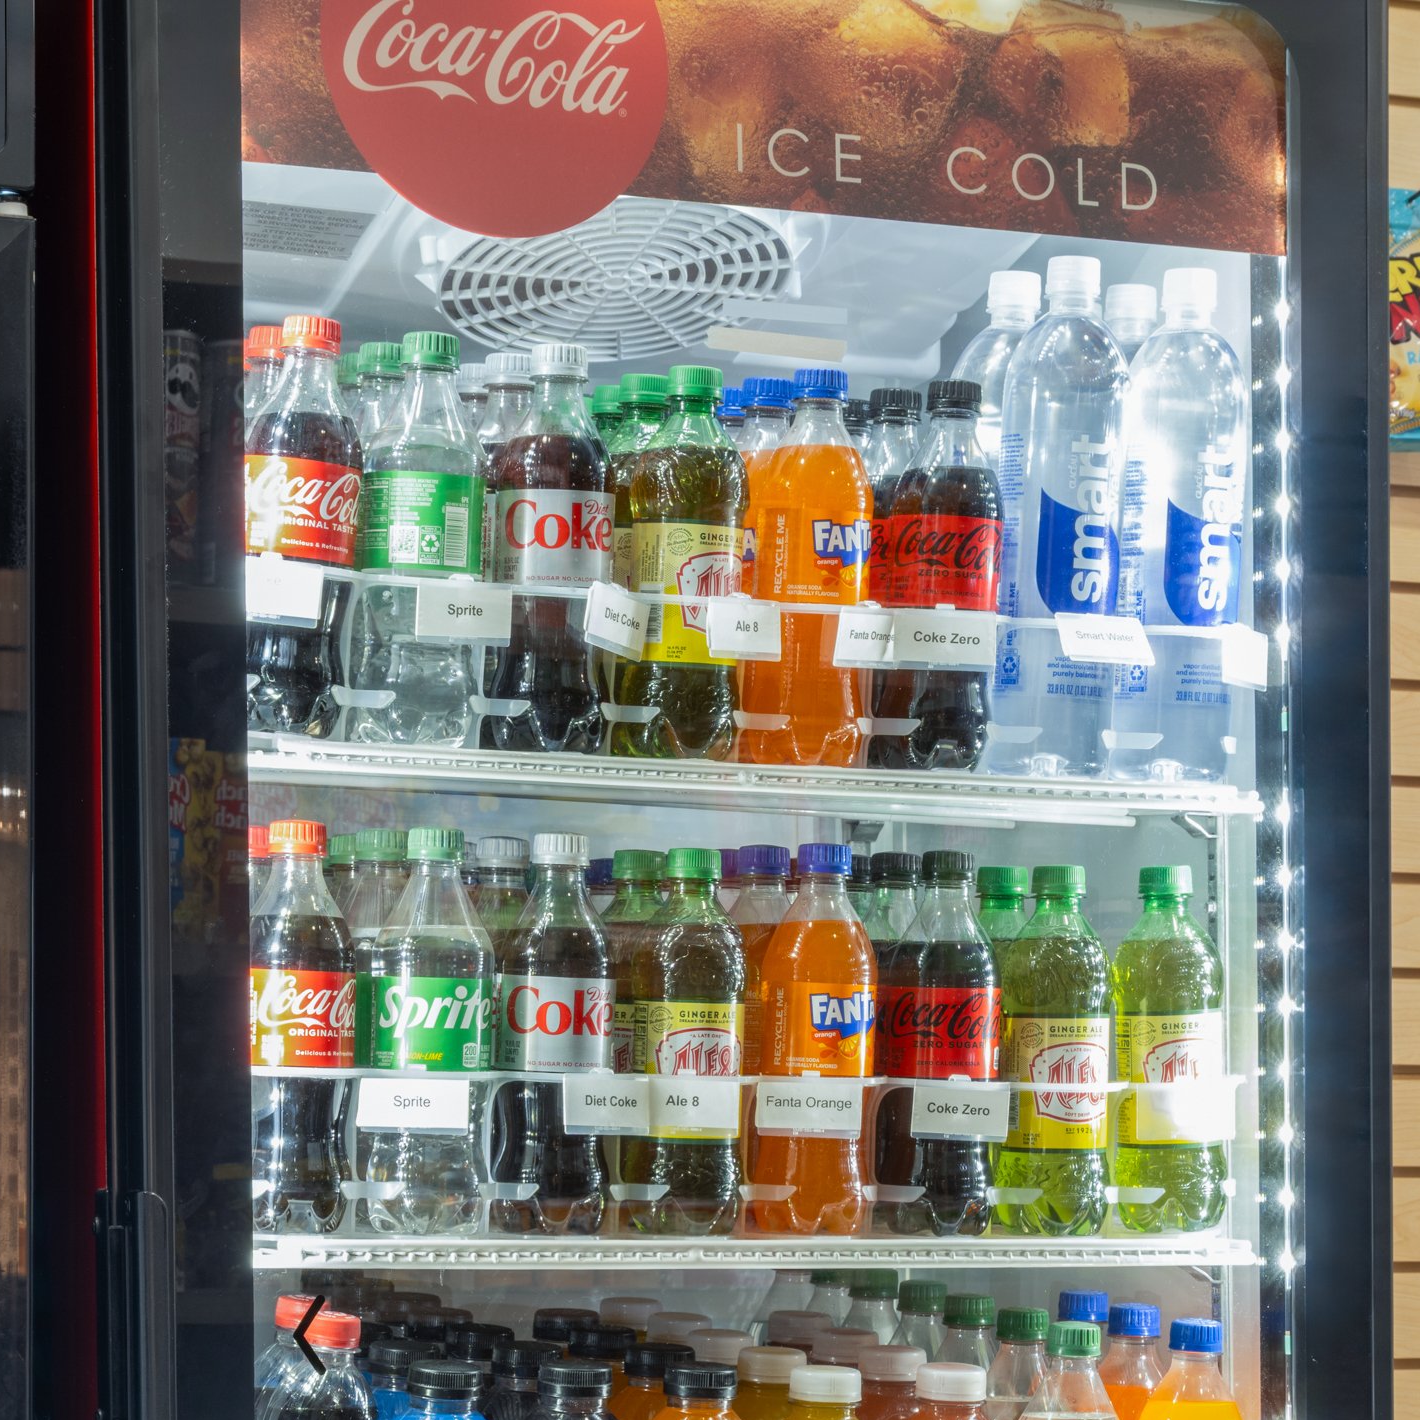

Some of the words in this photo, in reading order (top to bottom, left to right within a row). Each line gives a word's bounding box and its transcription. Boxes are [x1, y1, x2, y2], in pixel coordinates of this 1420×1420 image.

[343, 0, 646, 115] Coca-Cola
[736, 122, 862, 184] ICE
[946, 145, 1158, 211] COLD
[505, 499, 612, 552] Coke
[1071, 434, 1110, 603] smart
[447, 603, 483, 618] Sprite
[604, 607, 620, 622] Diet
[621, 613, 640, 631] Coke
[735, 620, 750, 632] Ale
[753, 621, 759, 632] 8
[849, 629, 869, 641] Fanta
[871, 630, 895, 644] Orange
[913, 631, 946, 644] Coke
[950, 632, 980, 646] Zero
[1076, 630, 1105, 640] Smart
[1108, 632, 1134, 642] Water
[379, 985, 491, 1038] Sprite
[506, 986, 612, 1037] Coke
[1049, 1025, 1086, 1033] GINGER
[1090, 1025, 1103, 1033] ALE
[393, 1095, 430, 1109] Sprite
[585, 1095, 606, 1106] Diet
[610, 1096, 637, 1108] Coke
[666, 1096, 688, 1106] Ale
[692, 1096, 700, 1106] 8
[766, 1096, 802, 1108] Fanta
[806, 1096, 852, 1112] Orange
[927, 1102, 959, 1116] Coke
[962, 1102, 990, 1116] Zero
